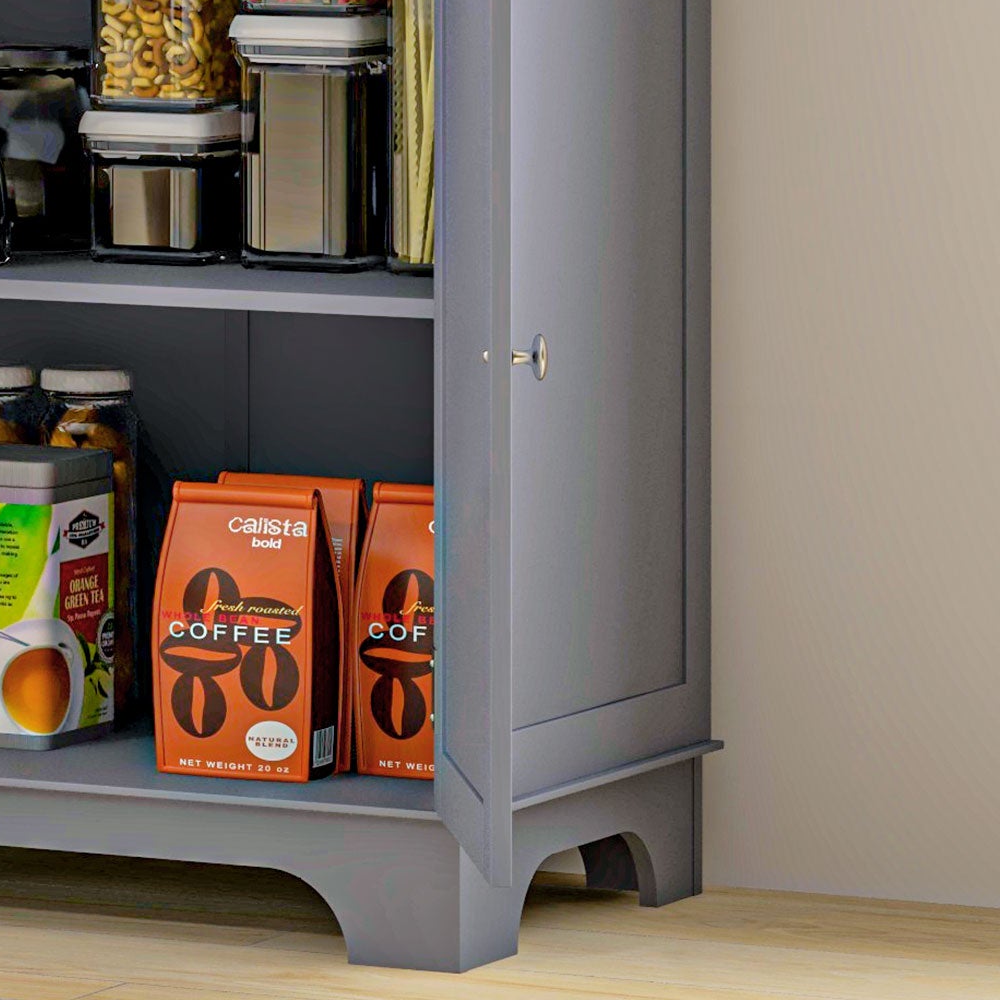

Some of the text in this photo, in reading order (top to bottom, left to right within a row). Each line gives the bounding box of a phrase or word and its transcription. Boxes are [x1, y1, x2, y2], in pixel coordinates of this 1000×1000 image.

[251, 537, 282, 549] bold
[69, 574, 99, 594] ORANGE
[64, 588, 105, 610] GREEN TEA
[200, 599, 304, 616] fresh roasted
[162, 610, 260, 625] WHOLE BEAN
[169, 621, 291, 645] COFFEE
[247, 736, 295, 744] NATURAL
[179, 758, 202, 767] NET
[206, 760, 253, 771] WEIGHT
[257, 764, 271, 772] 20
[379, 760, 401, 768] NET
